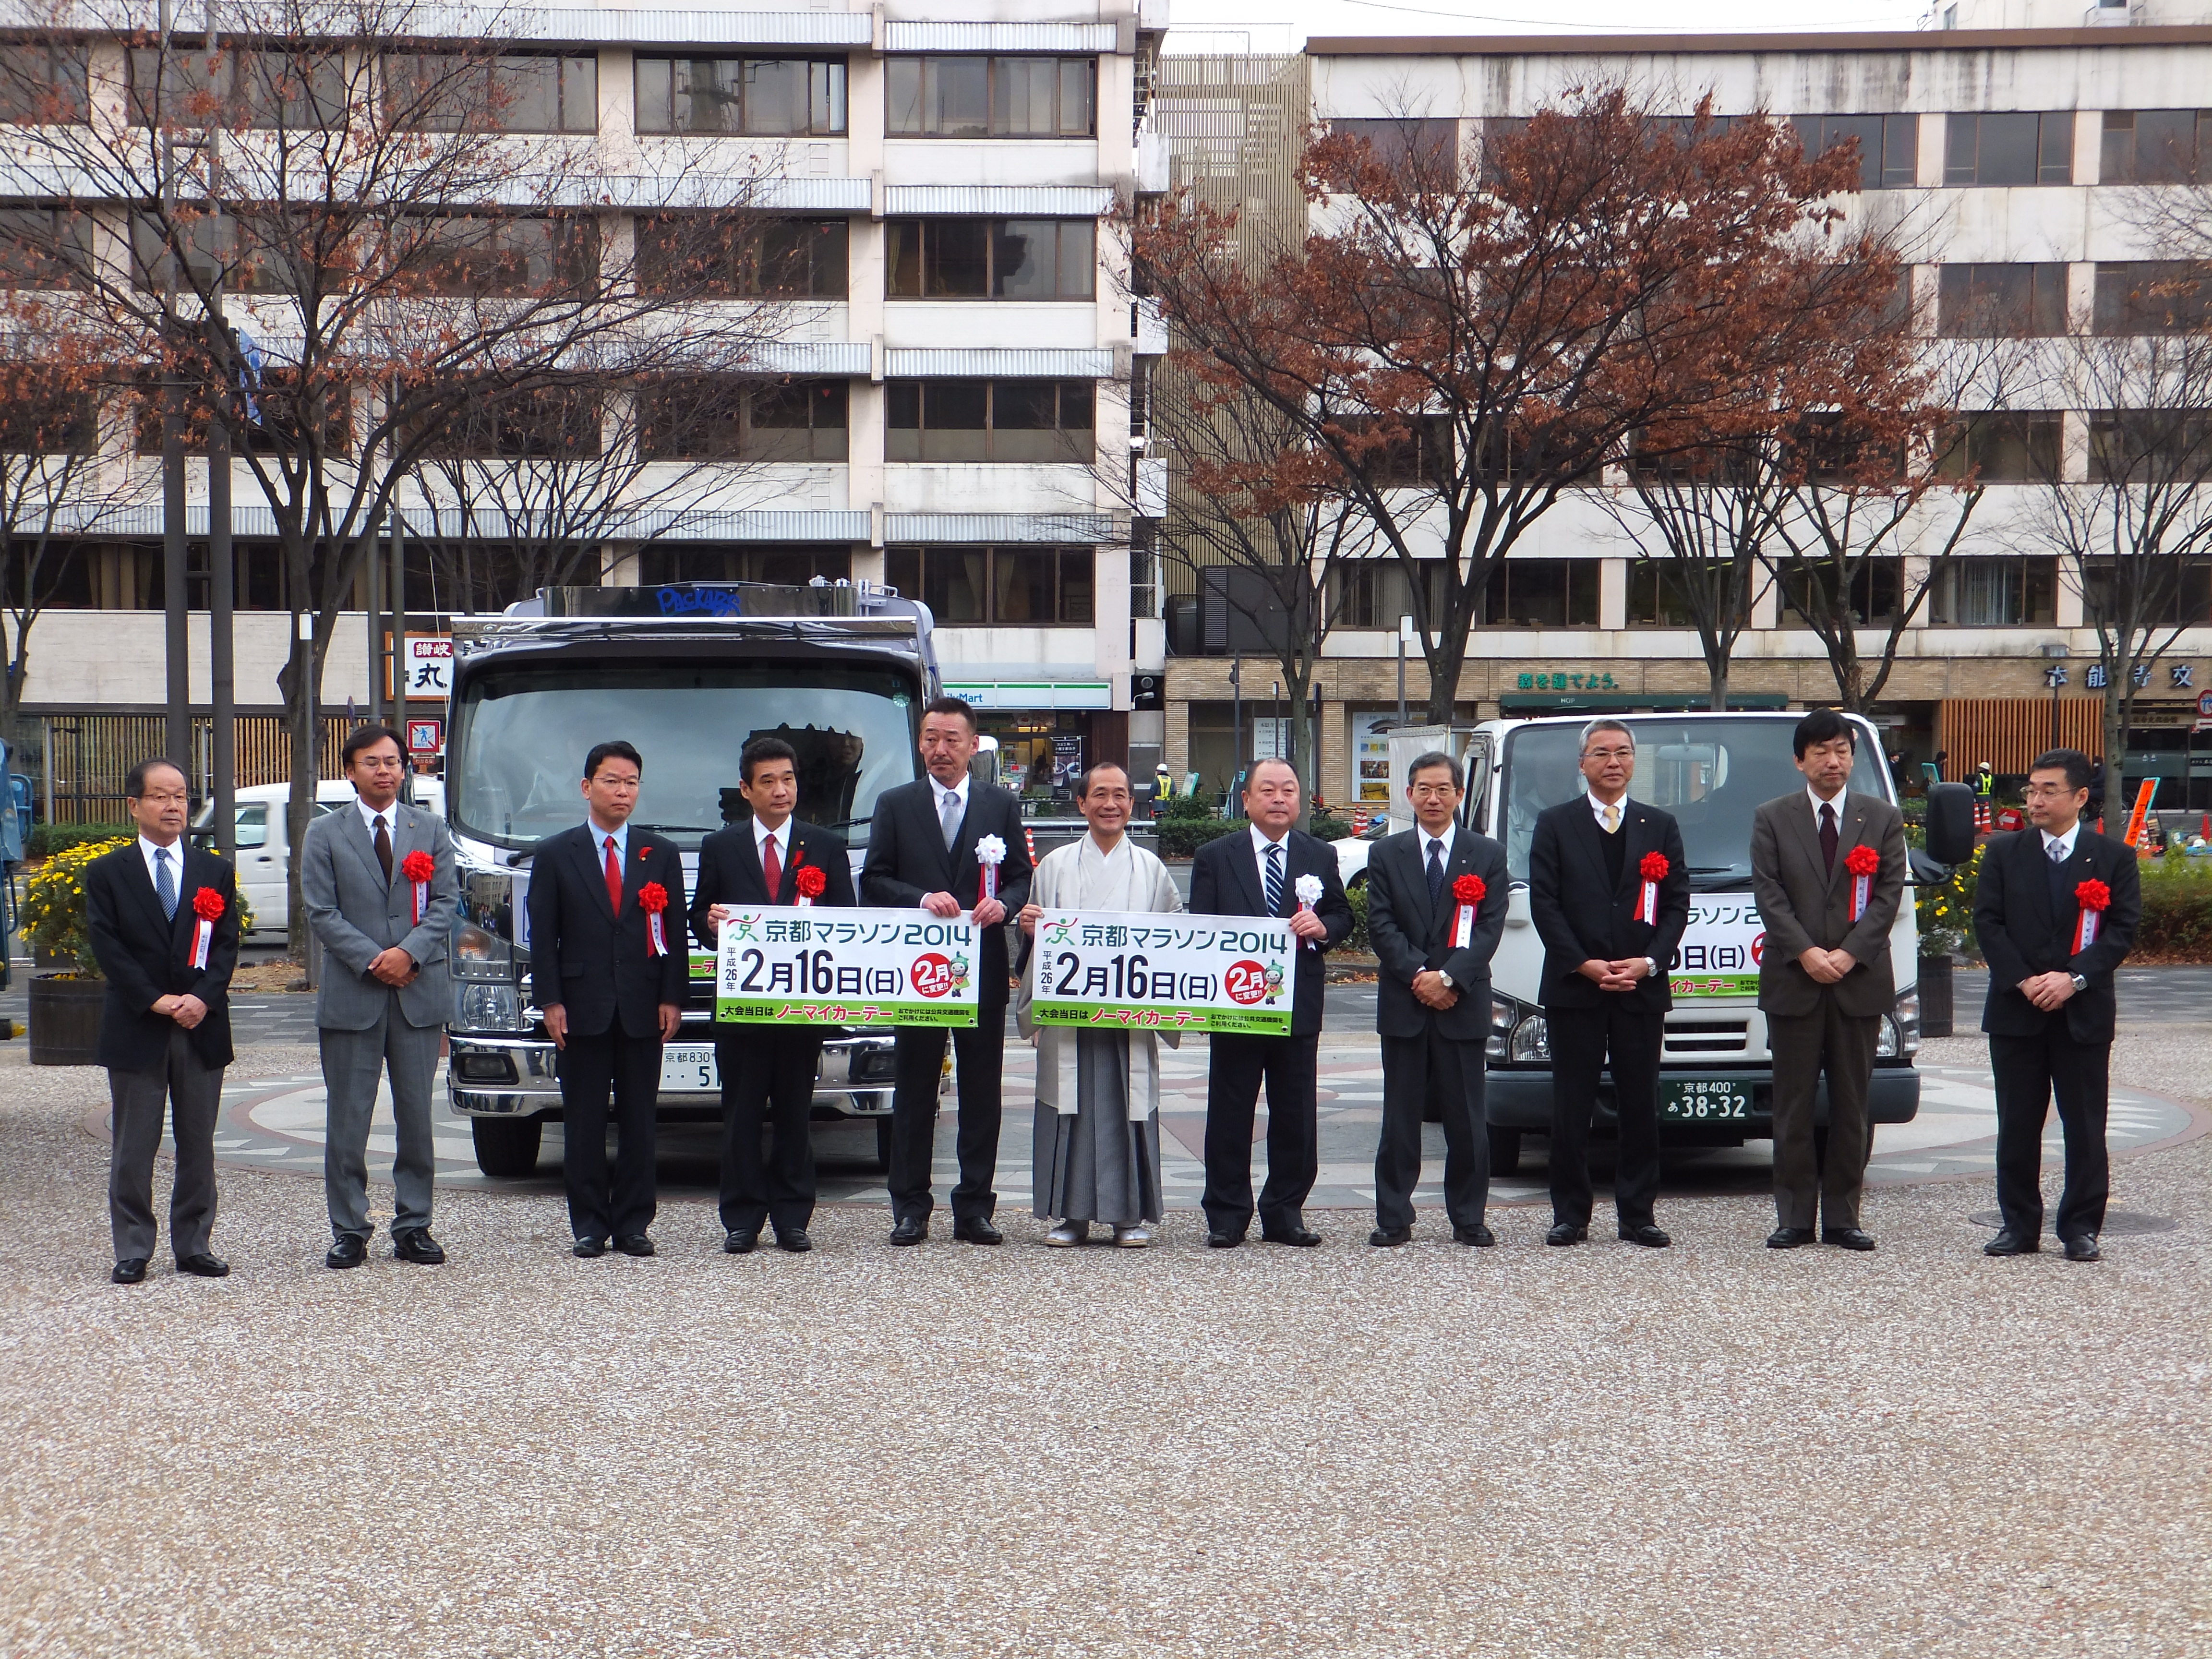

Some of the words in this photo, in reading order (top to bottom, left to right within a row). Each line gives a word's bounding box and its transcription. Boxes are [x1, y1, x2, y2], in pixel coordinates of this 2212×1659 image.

[414, 662, 448, 688] 丸
[765, 920, 972, 947] 京都マラソン2014
[1082, 925, 1288, 954] 京都マラソン2014
[725, 947, 737, 991] 平成26年
[741, 948, 903, 996] 2月16日(日)
[915, 960, 950, 986] 2月
[1041, 950, 1052, 994] 平成26年
[1056, 952, 1217, 1001] 2月16日(日)
[1229, 967, 1264, 993] 2月
[725, 1006, 774, 1016] 大会当日は
[776, 1004, 893, 1021] ノーマイカーデー
[1040, 1009, 1088, 1019] 大会当日は
[1090, 1008, 1205, 1026] ノーマイカーデー
[1668, 1101, 1678, 1113] あ
[1682, 1095, 1745, 1118] 38-32
